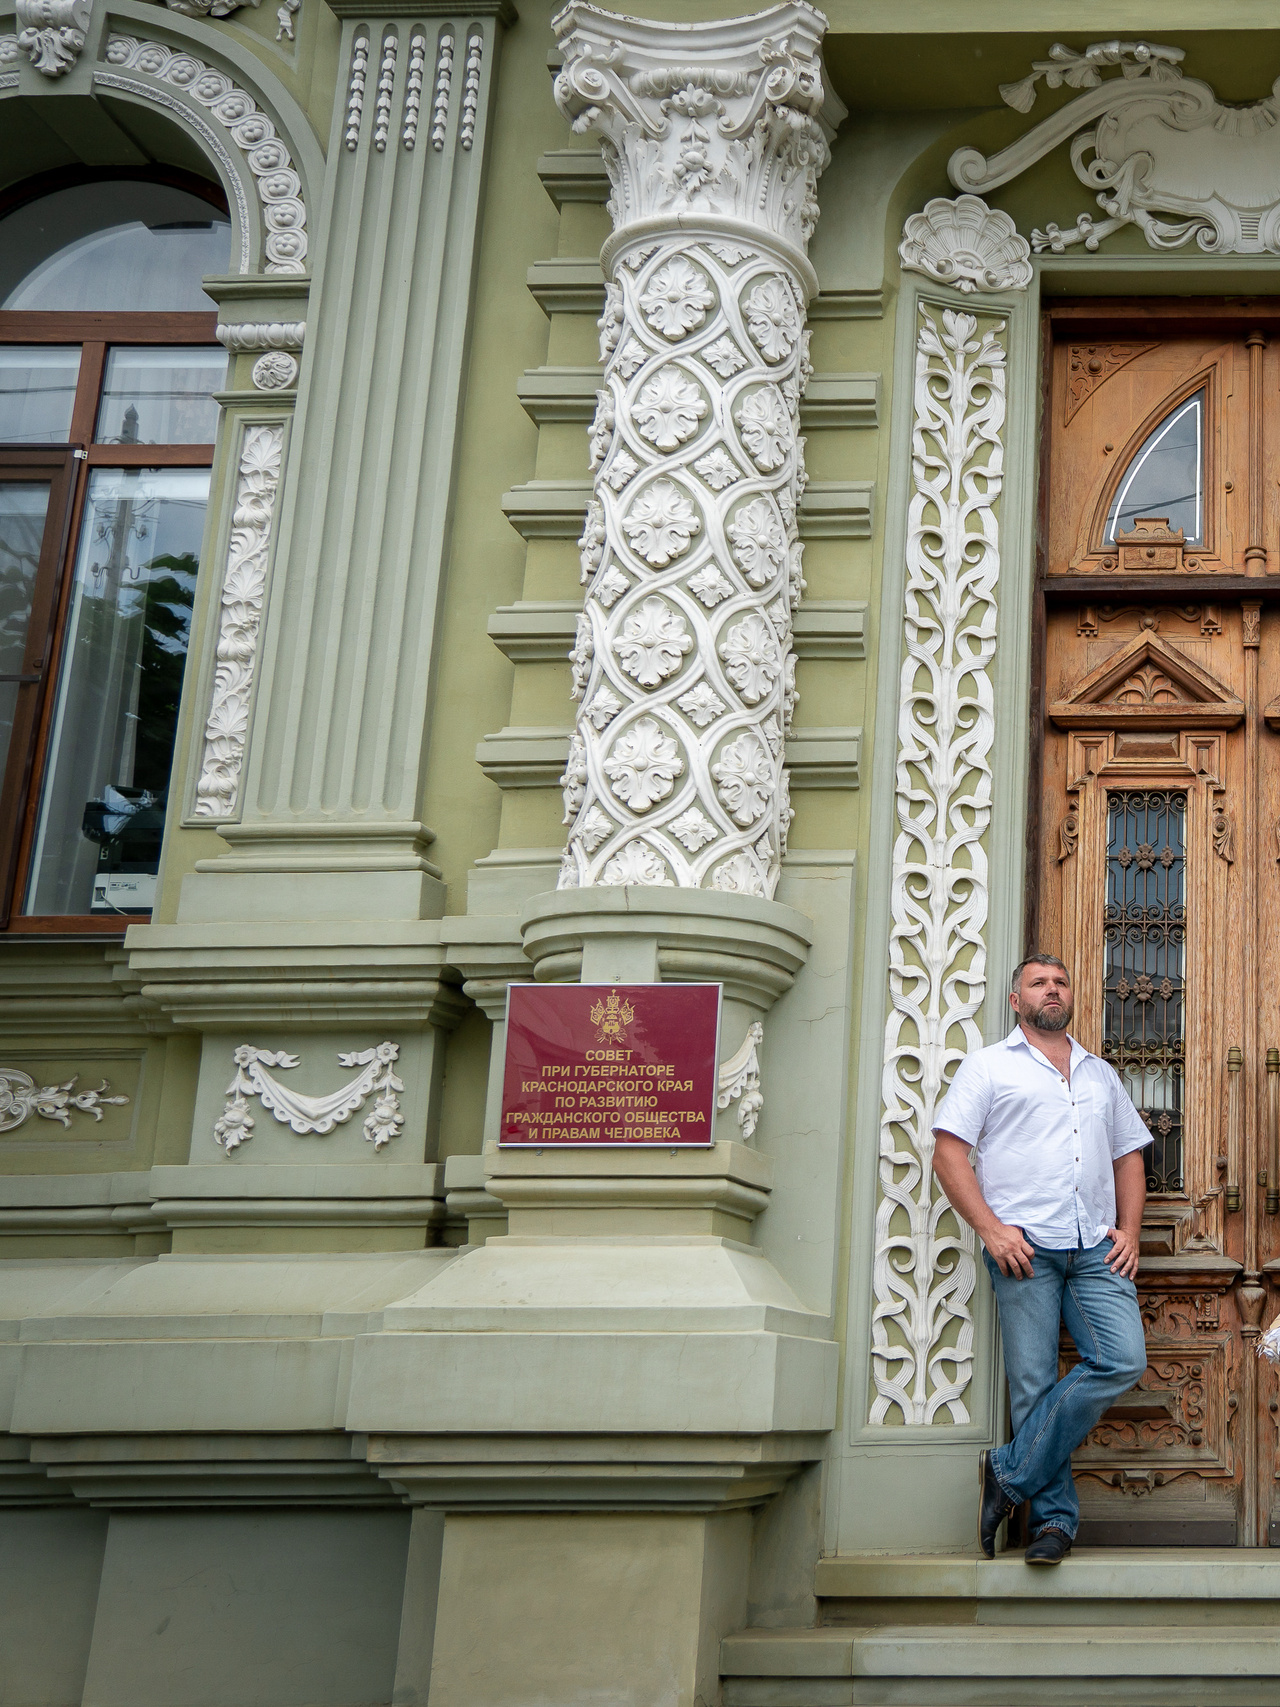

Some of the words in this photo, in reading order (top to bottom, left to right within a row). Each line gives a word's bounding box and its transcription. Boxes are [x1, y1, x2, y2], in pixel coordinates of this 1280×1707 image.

[585, 1050, 633, 1061] СОВЕТ
[542, 1065, 570, 1076] ПРИ
[574, 1065, 675, 1076] ГУБЕРНАТОРЕ
[522, 1081, 653, 1094] КРАСНОДАРСКОГО
[657, 1081, 693, 1091] КРАЯ
[555, 1097, 575, 1107] ПО
[580, 1096, 657, 1107] РАЗВИТИЮ
[506, 1112, 620, 1125] ГРАЖДАНСКОГО
[625, 1112, 705, 1124] ОБЩЕСТВА
[528, 1128, 537, 1138] И
[542, 1128, 600, 1138] ПРАВАМ
[604, 1128, 681, 1138] ЧЕЛОВЕКА
